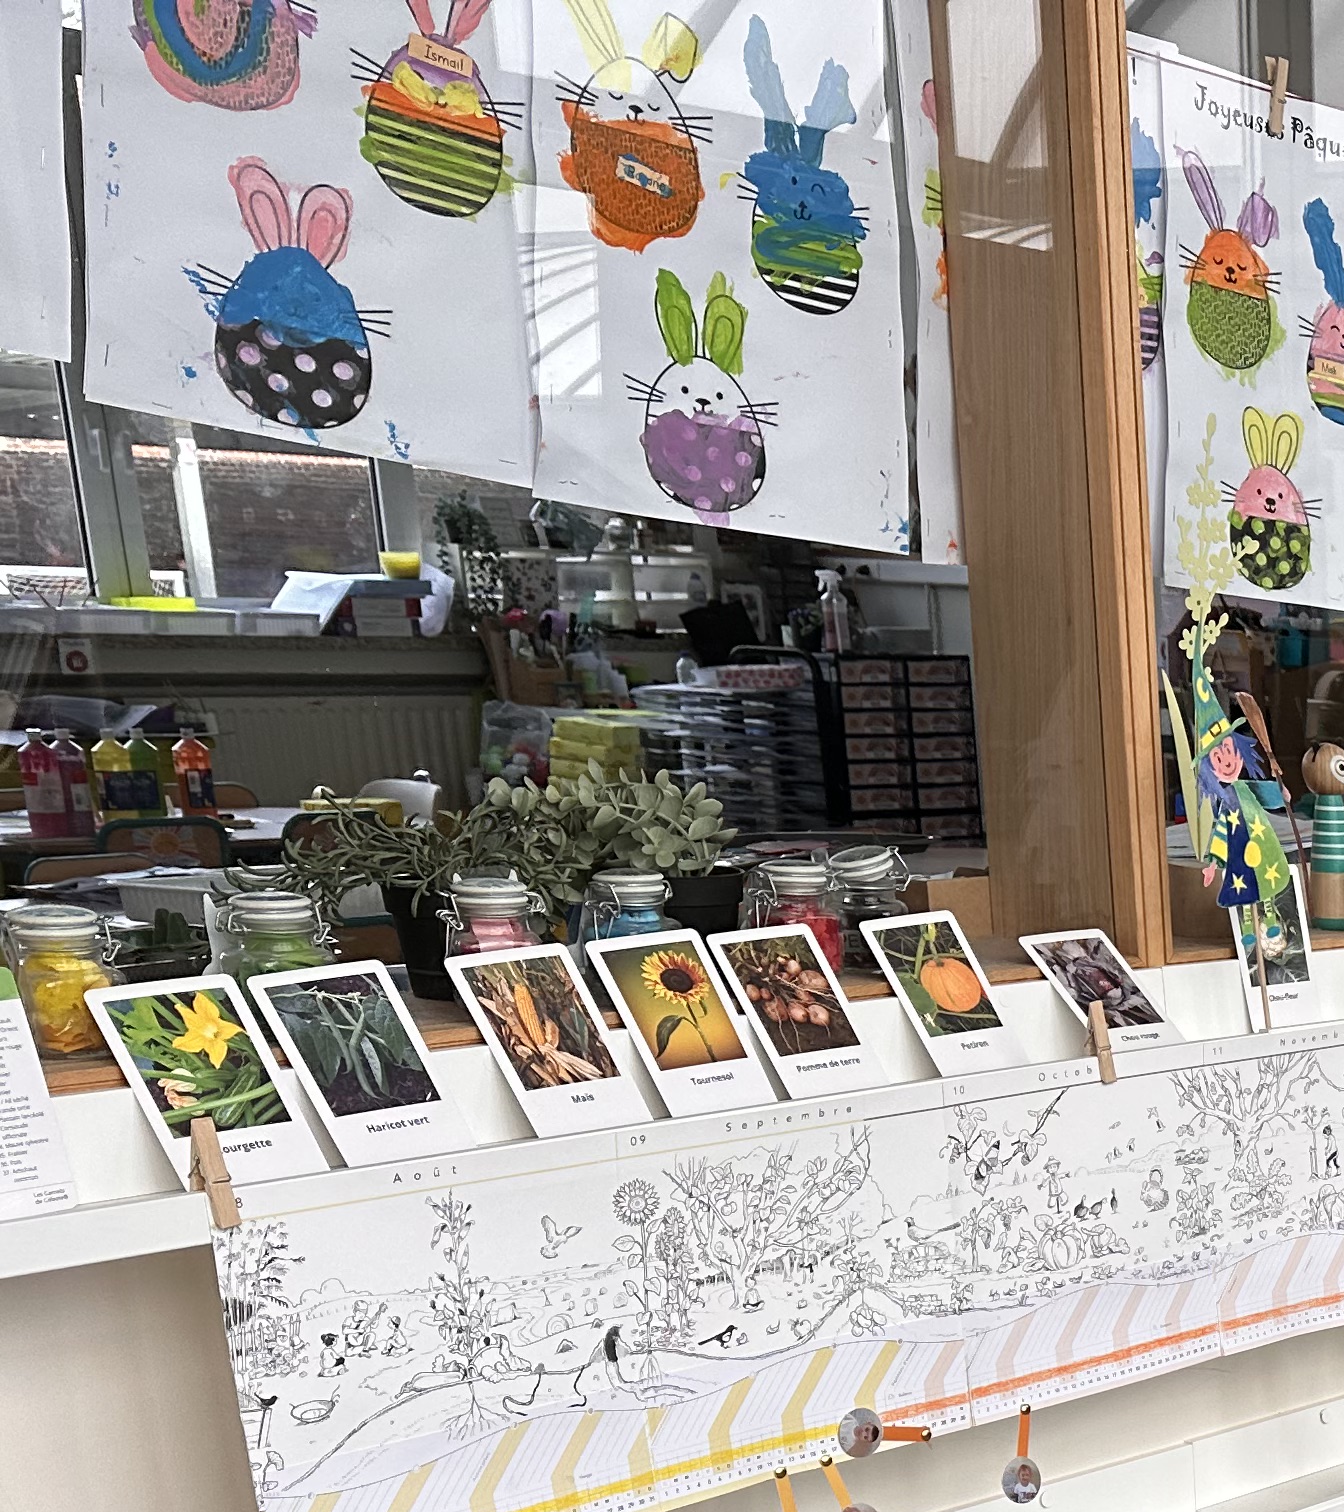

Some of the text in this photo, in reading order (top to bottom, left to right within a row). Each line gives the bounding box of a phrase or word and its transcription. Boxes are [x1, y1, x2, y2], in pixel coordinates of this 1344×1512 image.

[1212, 1046, 1224, 1056] 11
[953, 1065, 1093, 1096] 10 Octob
[366, 1115, 430, 1134] Haricot vert
[630, 1105, 853, 1147] 09 Septembre
[222, 1138, 273, 1154] ourgette
[235, 1164, 457, 1209] 8 Août
